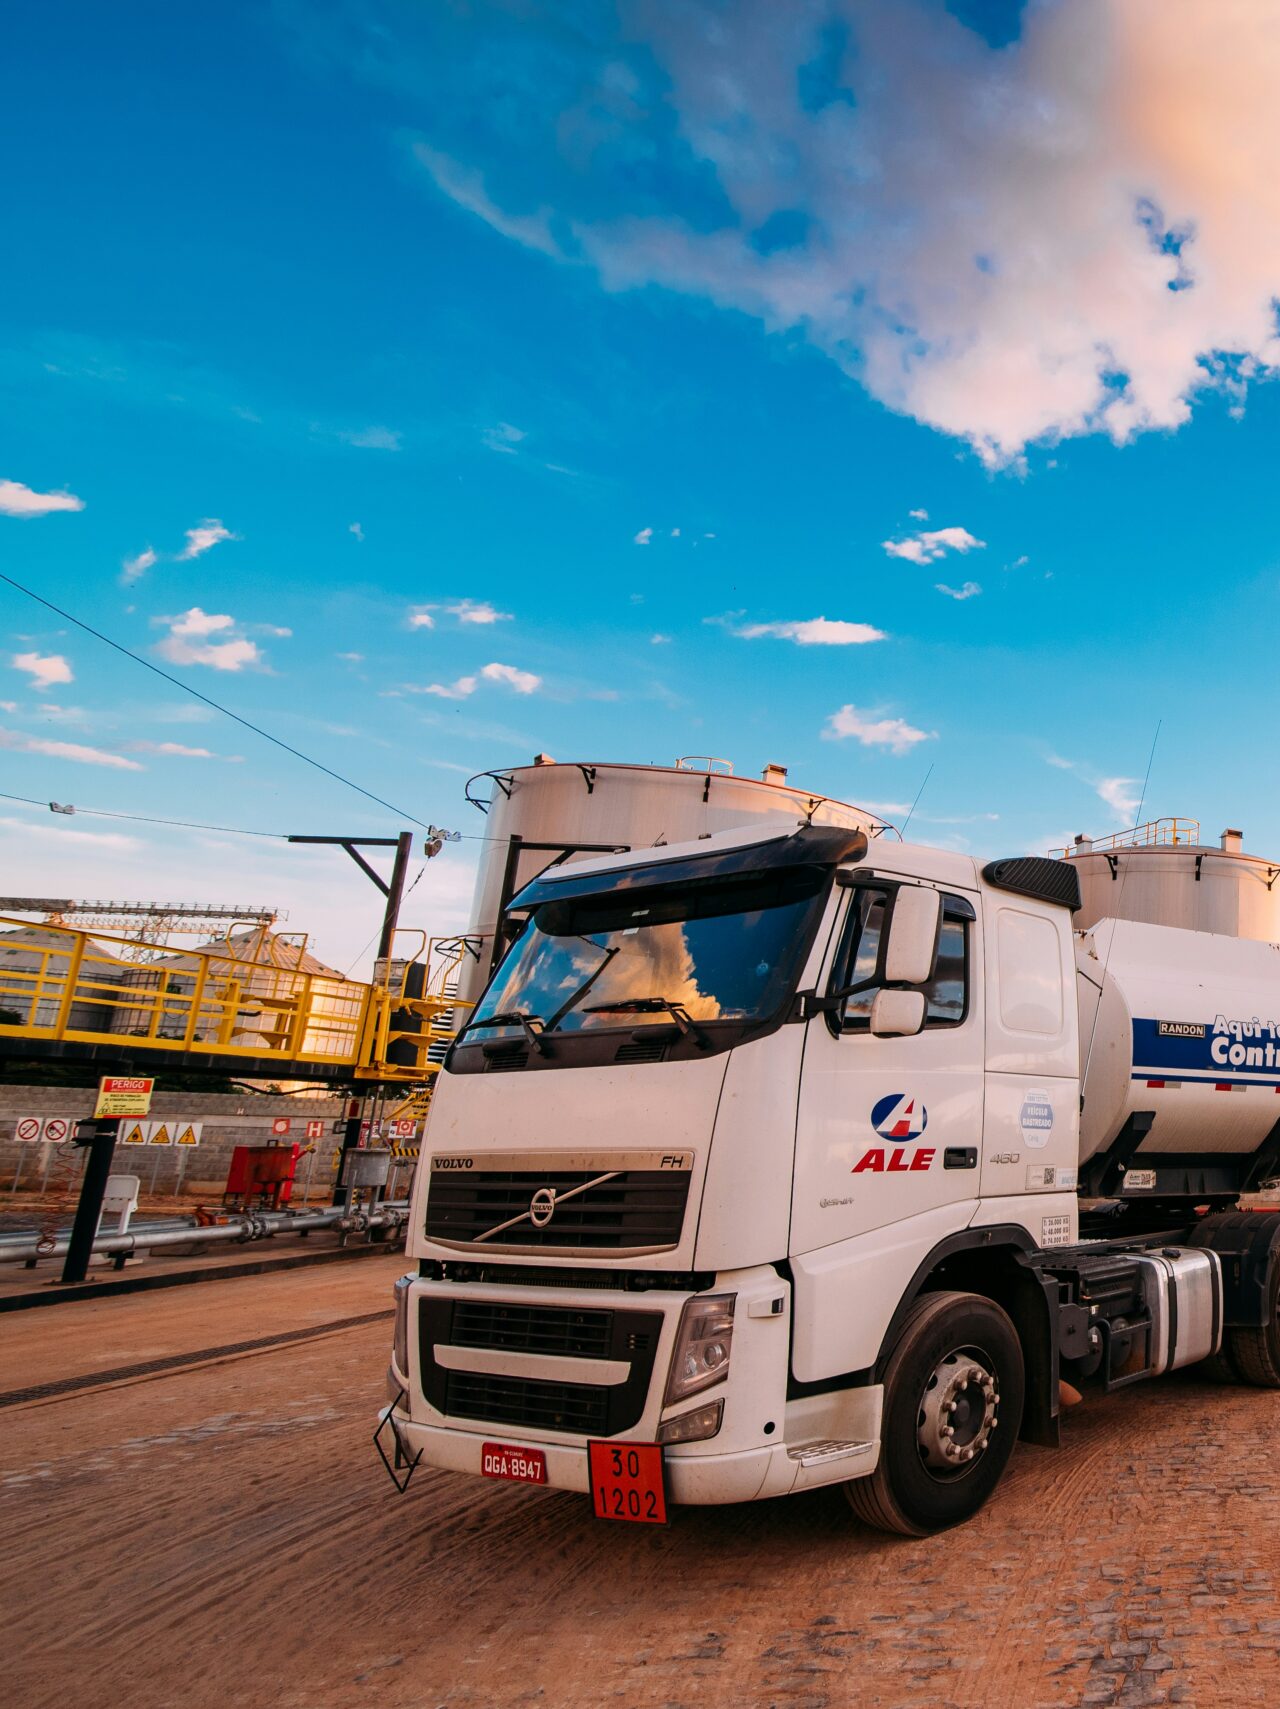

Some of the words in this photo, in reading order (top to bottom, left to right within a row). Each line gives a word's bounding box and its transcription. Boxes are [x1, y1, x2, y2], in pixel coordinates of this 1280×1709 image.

[1161, 1023, 1204, 1035] RANDON
[1212, 1015, 1262, 1042] Aqui
[111, 1080, 145, 1089] PERIGO
[1027, 1106, 1048, 1116] VEÍCULO
[1022, 1118, 1052, 1128] RASTREADO
[308, 1122, 322, 1137] H
[434, 1158, 474, 1169] VOLVO
[660, 1156, 684, 1168] FH
[851, 1148, 937, 1173] ALE
[990, 1153, 1020, 1165] 460
[531, 1204, 553, 1212] VOLVO
[611, 1449, 639, 1478] 30
[600, 1486, 658, 1519] 1202
